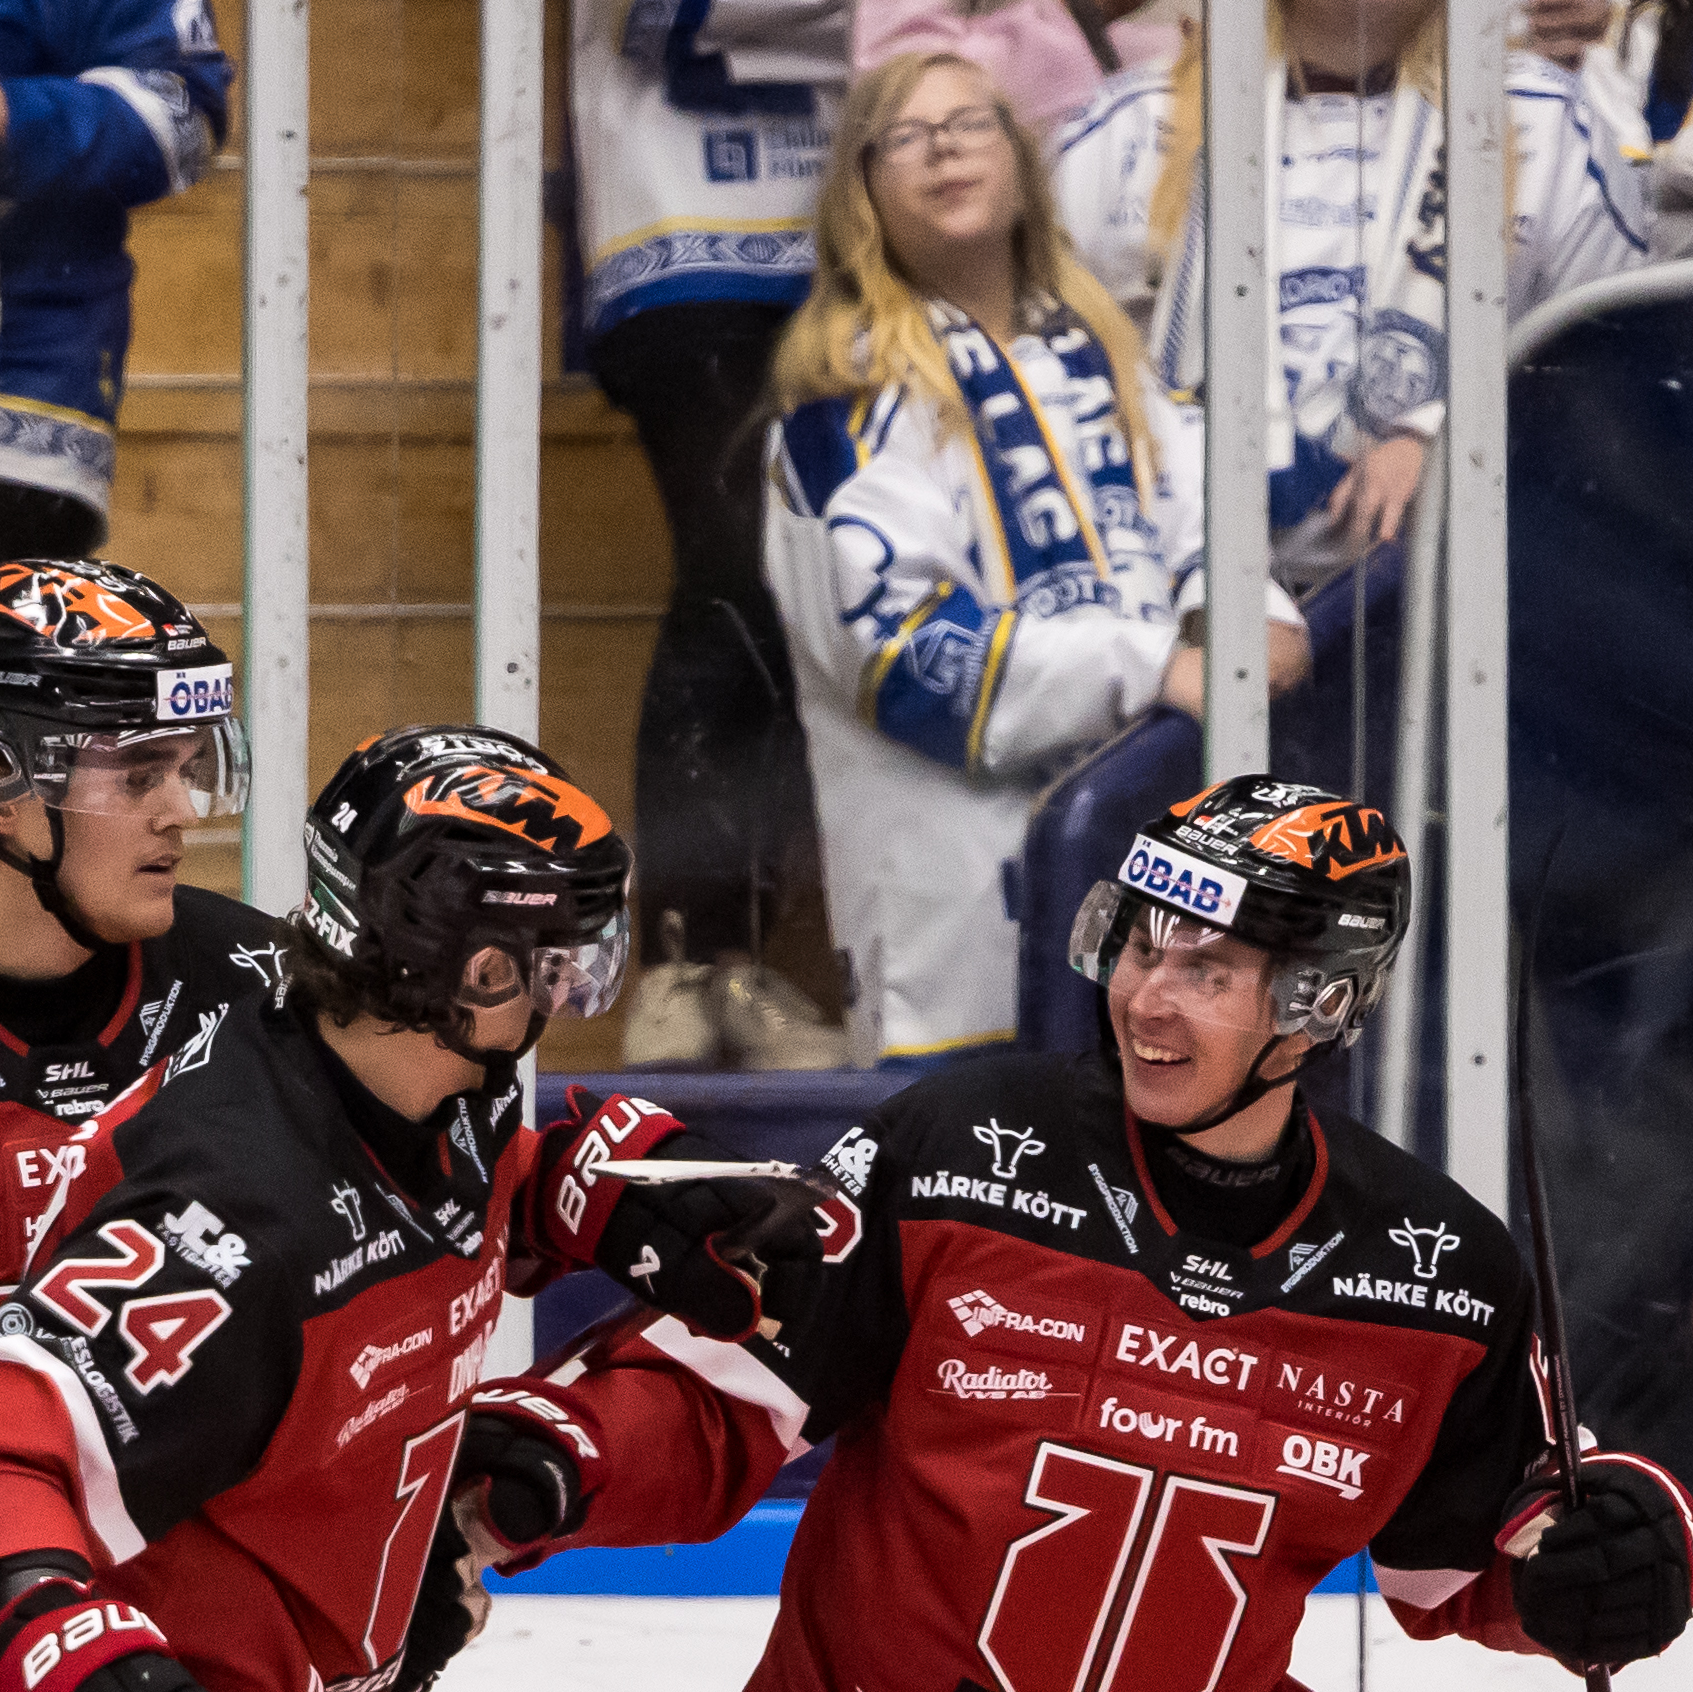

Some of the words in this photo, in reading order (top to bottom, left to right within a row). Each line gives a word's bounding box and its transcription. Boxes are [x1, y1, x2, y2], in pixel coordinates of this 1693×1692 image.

[1127, 838, 1225, 914] ÖBAB
[44, 1061, 95, 1082] SHL
[911, 1170, 1008, 1207] NÄRKE
[1011, 1188, 1087, 1230] KÖTT
[1182, 1254, 1233, 1281] SHL
[1332, 1272, 1428, 1309] NÄRKE
[1434, 1289, 1495, 1327] KÖTT
[30, 1218, 233, 1397] 24
[1116, 1323, 1259, 1392] EXACT
[1277, 1362, 1405, 1424] NASTA
[937, 1358, 1053, 1398] Radiator
[1100, 1397, 1183, 1444] four
[1189, 1416, 1239, 1458] fm
[1281, 1434, 1371, 1488] OBK
